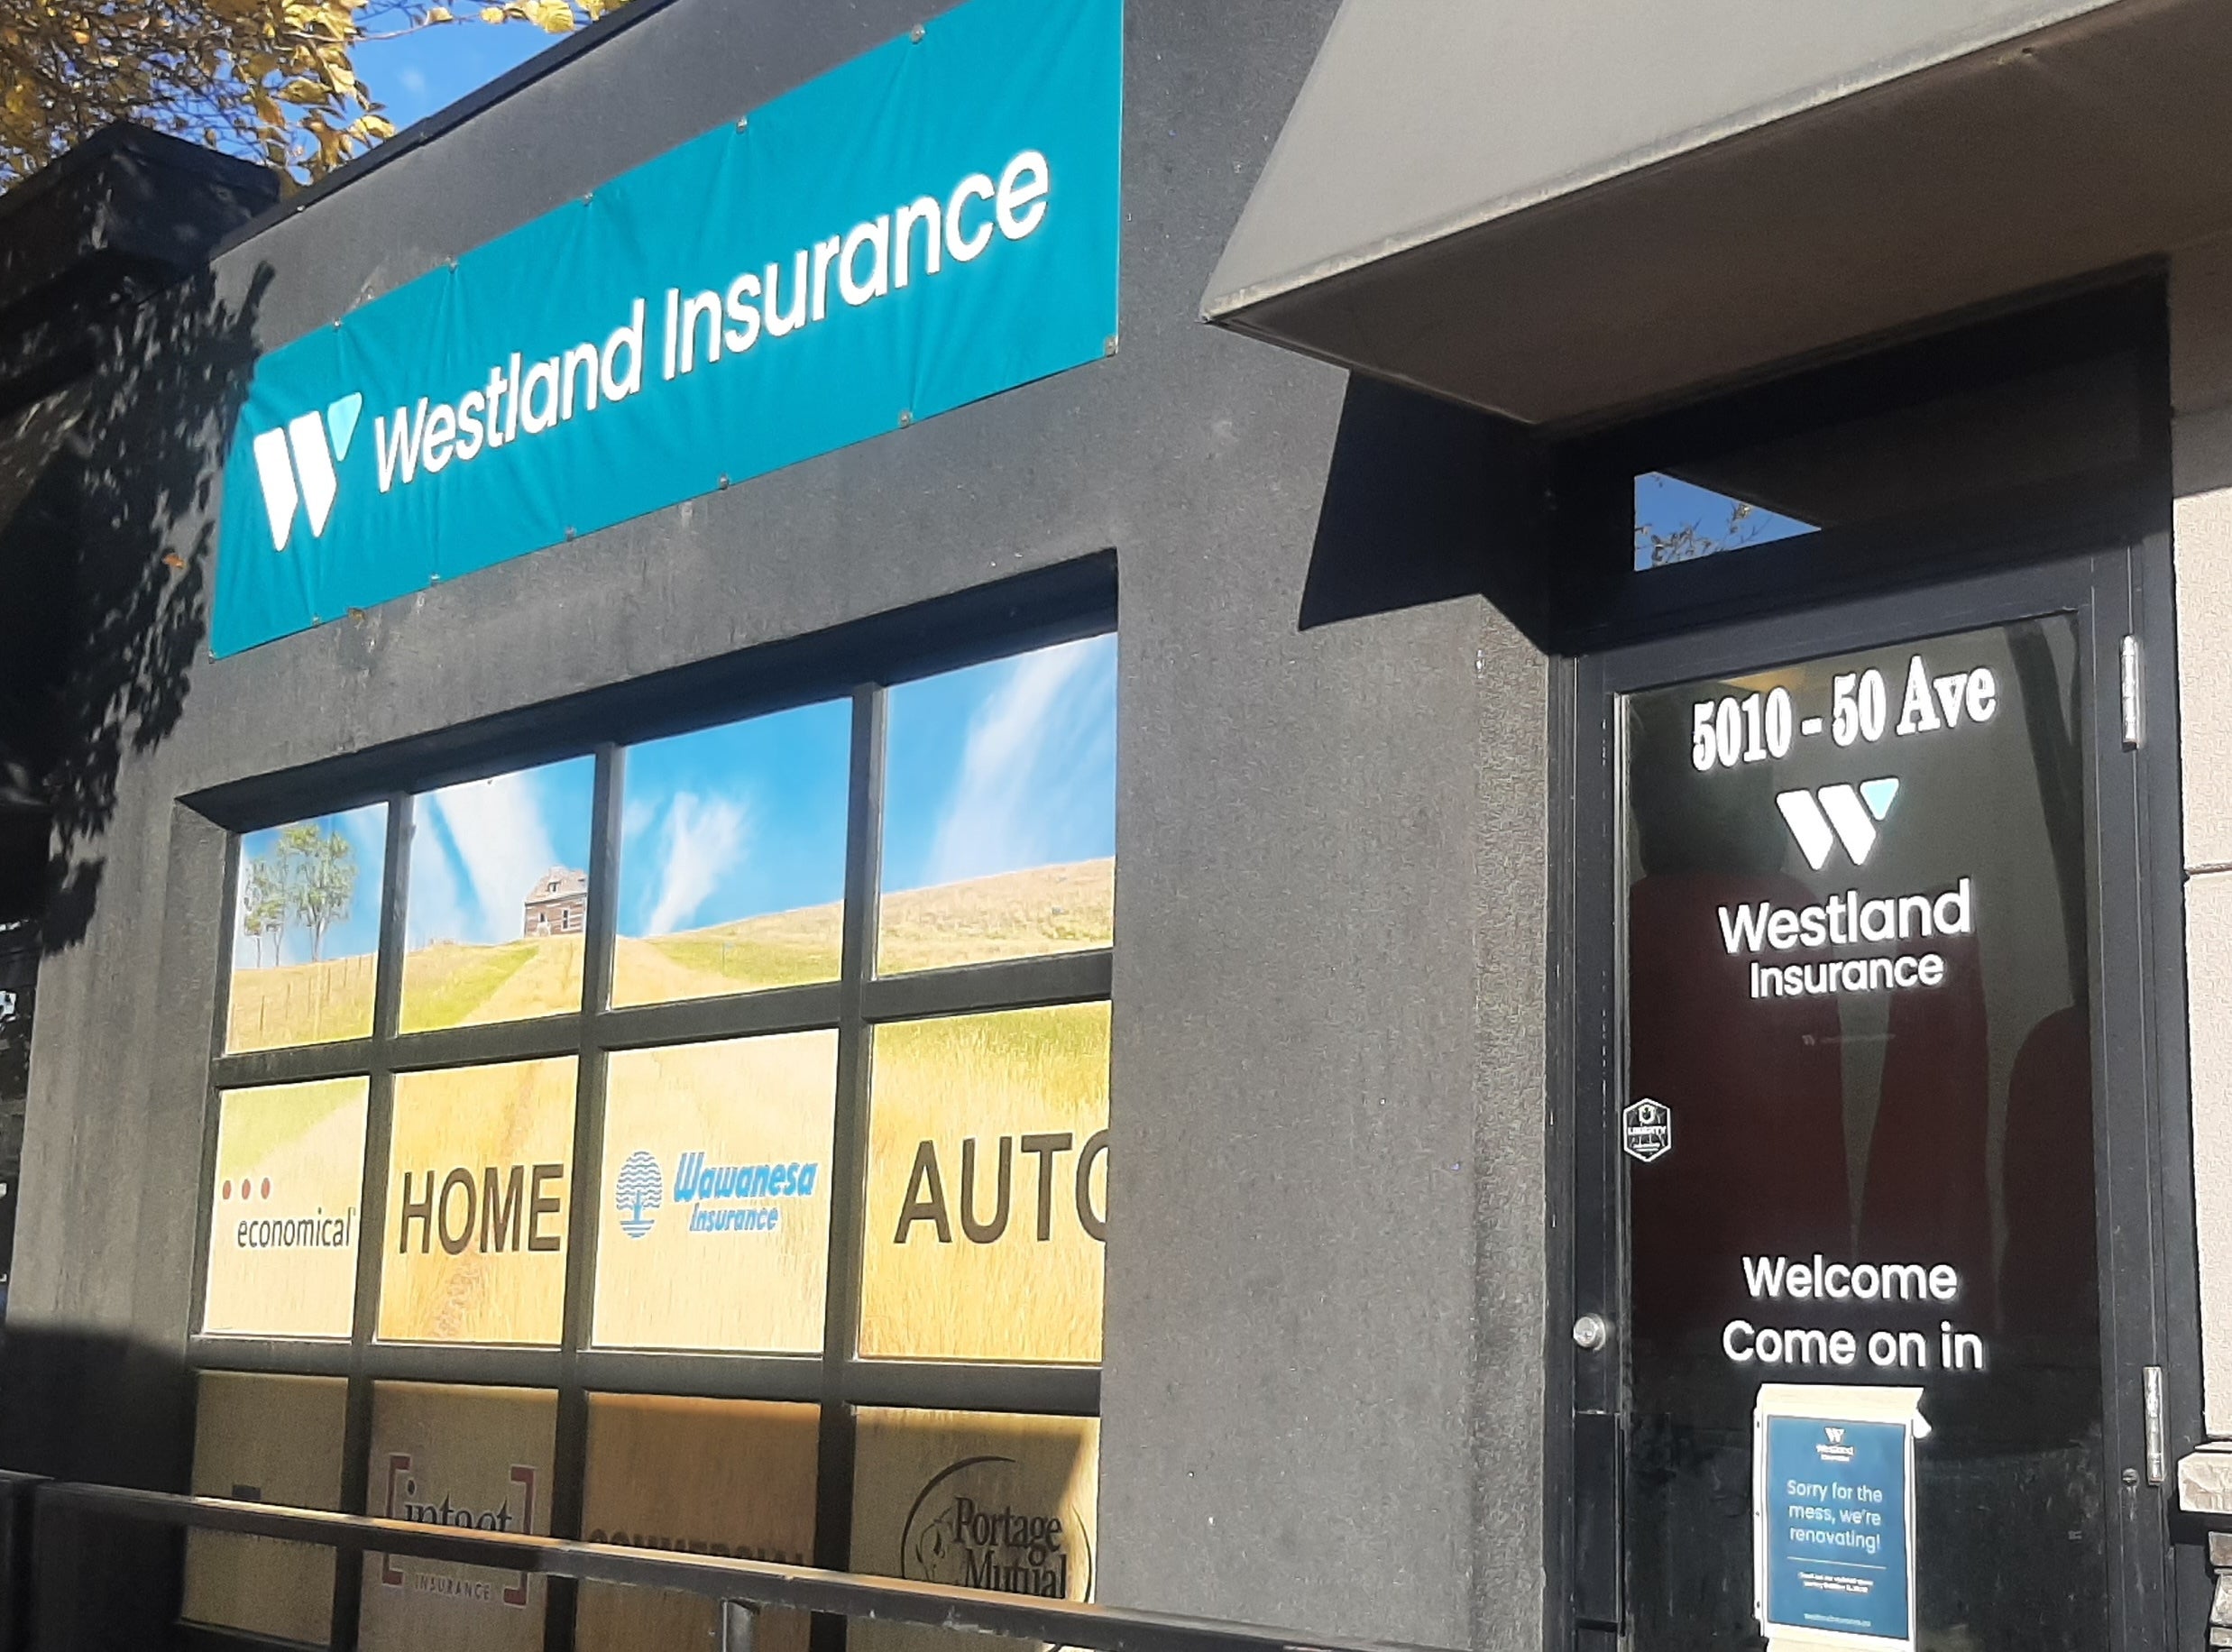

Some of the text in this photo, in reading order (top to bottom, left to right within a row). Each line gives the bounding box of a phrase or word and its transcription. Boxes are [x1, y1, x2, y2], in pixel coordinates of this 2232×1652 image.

[374, 150, 1049, 492] Westland Insurance
[1692, 687, 1792, 771] 5010
[1832, 669, 1887, 747] 50
[1897, 655, 1998, 735] Ave
[1718, 878, 1971, 954] Westland
[1750, 952, 1944, 998] Insurance
[673, 1152, 818, 1202] Wawanesa
[237, 1207, 351, 1248] economical
[400, 1164, 565, 1254] HOME
[689, 1203, 779, 1233] Insurance
[1742, 1254, 1959, 1299] Welcome
[1722, 1320, 1984, 1369] Come on in
[1787, 1480, 1883, 1503] Sorry for the
[953, 1497, 1063, 1567] Portage
[1789, 1505, 1881, 1526] mess, we're
[1790, 1528, 1880, 1554] renovating!
[416, 1574, 491, 1601] INSURANCE
